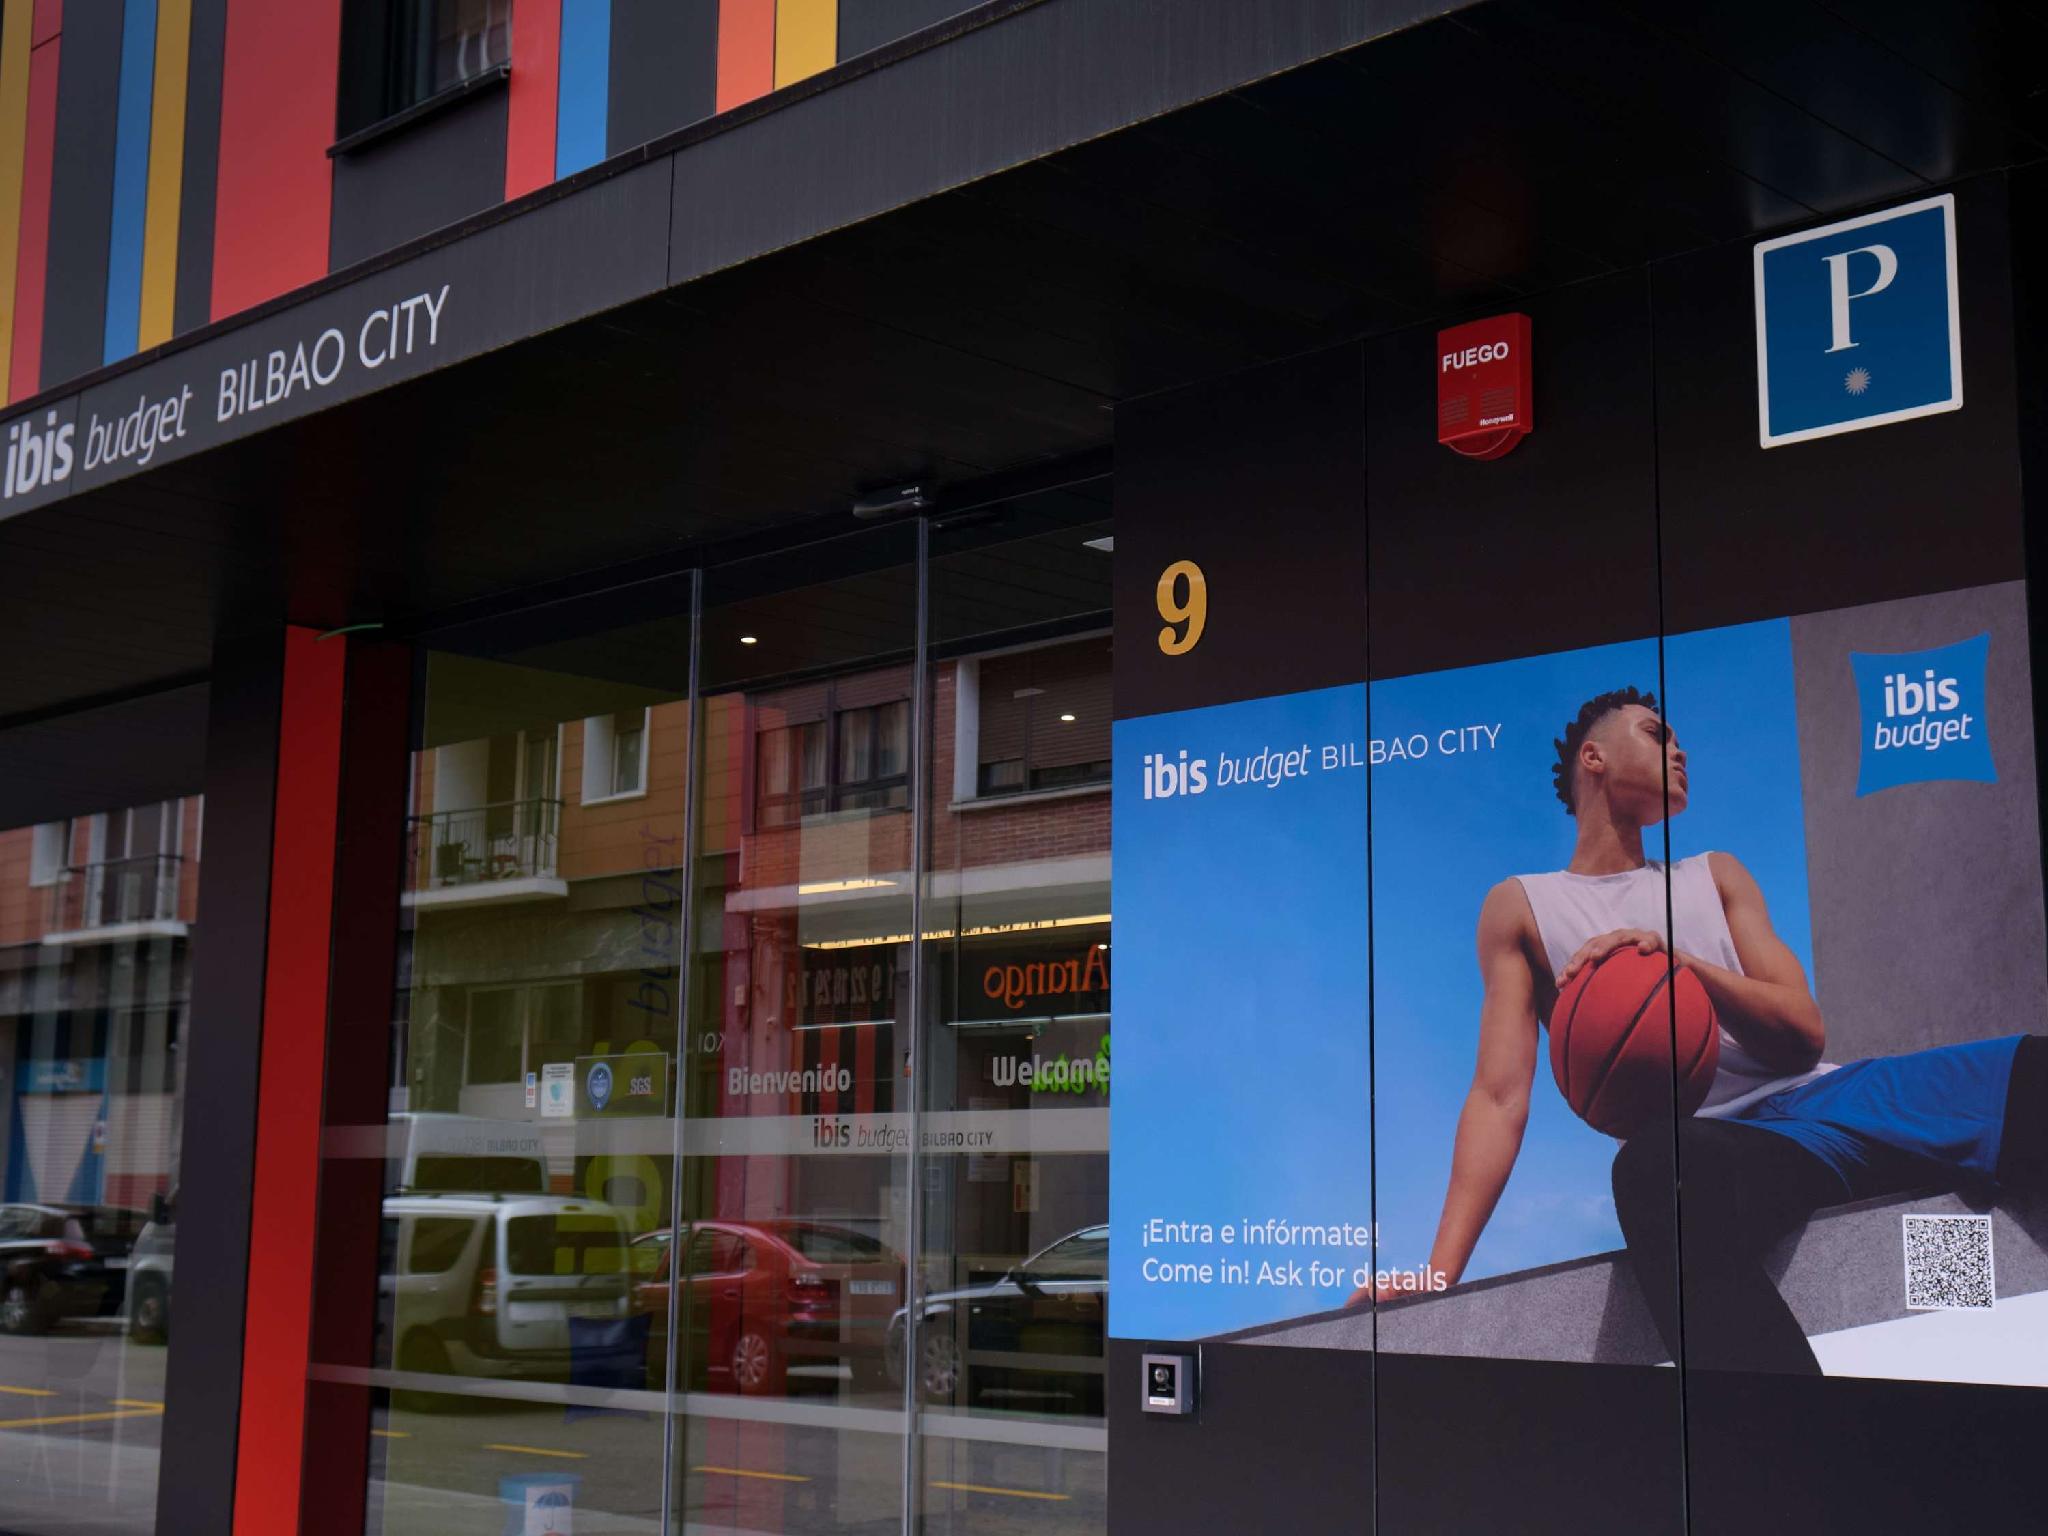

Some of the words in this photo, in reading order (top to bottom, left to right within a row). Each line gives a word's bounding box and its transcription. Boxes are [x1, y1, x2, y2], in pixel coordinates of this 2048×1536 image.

[1822, 244, 1898, 353] P
[1442, 341, 1509, 373] FUEGO
[4, 410, 75, 499] ibis
[84, 383, 193, 471] budget
[217, 328, 345, 423] BILBAO
[359, 284, 450, 369] CITY
[1156, 559, 1207, 656] 9
[1884, 670, 1960, 718] ibis
[1874, 713, 1973, 751] budget
[1143, 750, 1207, 800] ibis
[1216, 744, 1312, 789] budget
[1321, 734, 1429, 770] BILBAO
[1438, 723, 1502, 755] CITY
[728, 1062, 851, 1096] Bienvenido
[992, 1054, 1110, 1087] Welcome
[813, 1118, 850, 1148] ibis
[922, 1131, 963, 1147] BILBAO
[967, 1130, 993, 1146] CITY
[1142, 1218, 1213, 1248] ¡Entra
[1221, 1227, 1235, 1244] e
[1243, 1218, 1379, 1247] infórmate!
[1142, 1258, 1213, 1284] Come
[1221, 1258, 1250, 1284] in!
[1257, 1261, 1303, 1287] Ask
[1309, 1261, 1346, 1288] for
[1353, 1262, 1448, 1292] details
